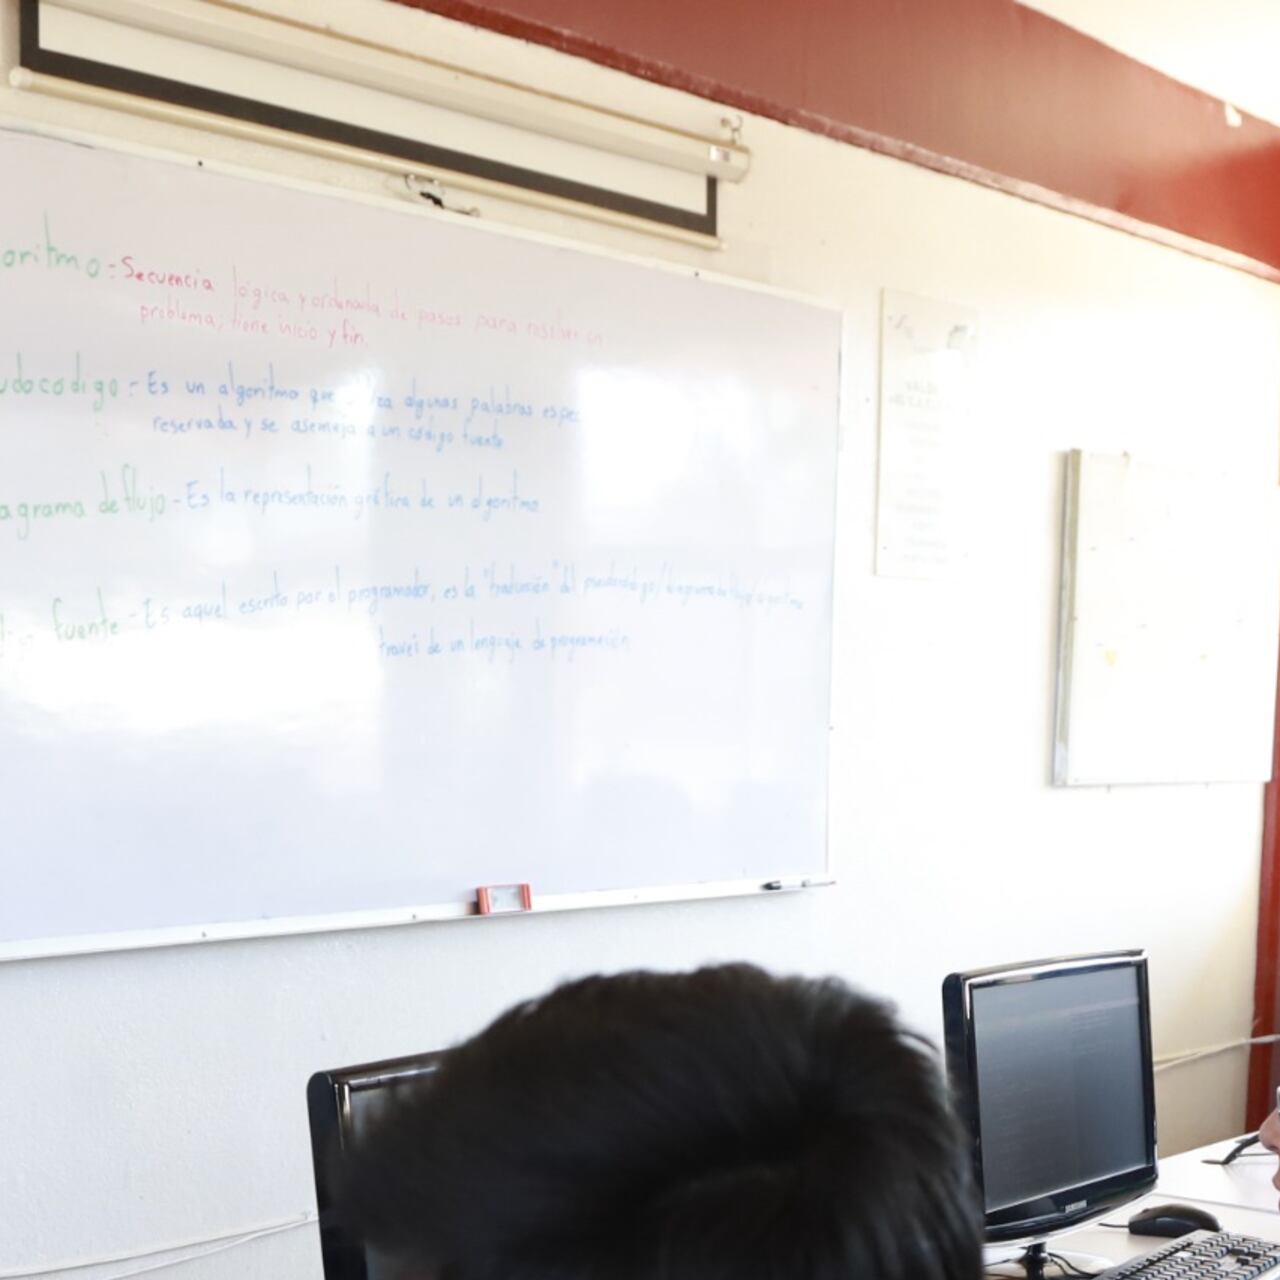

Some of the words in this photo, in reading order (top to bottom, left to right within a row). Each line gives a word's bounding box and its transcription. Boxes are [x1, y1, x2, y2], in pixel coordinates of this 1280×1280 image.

[121, 255, 215, 291] Secuencia
[147, 370, 170, 396] Es
[185, 380, 206, 395] un
[218, 360, 300, 407] algoritmo
[260, 418, 279, 433] se
[185, 479, 210, 509] Es
[220, 465, 237, 504] la
[297, 588, 322, 611] por
